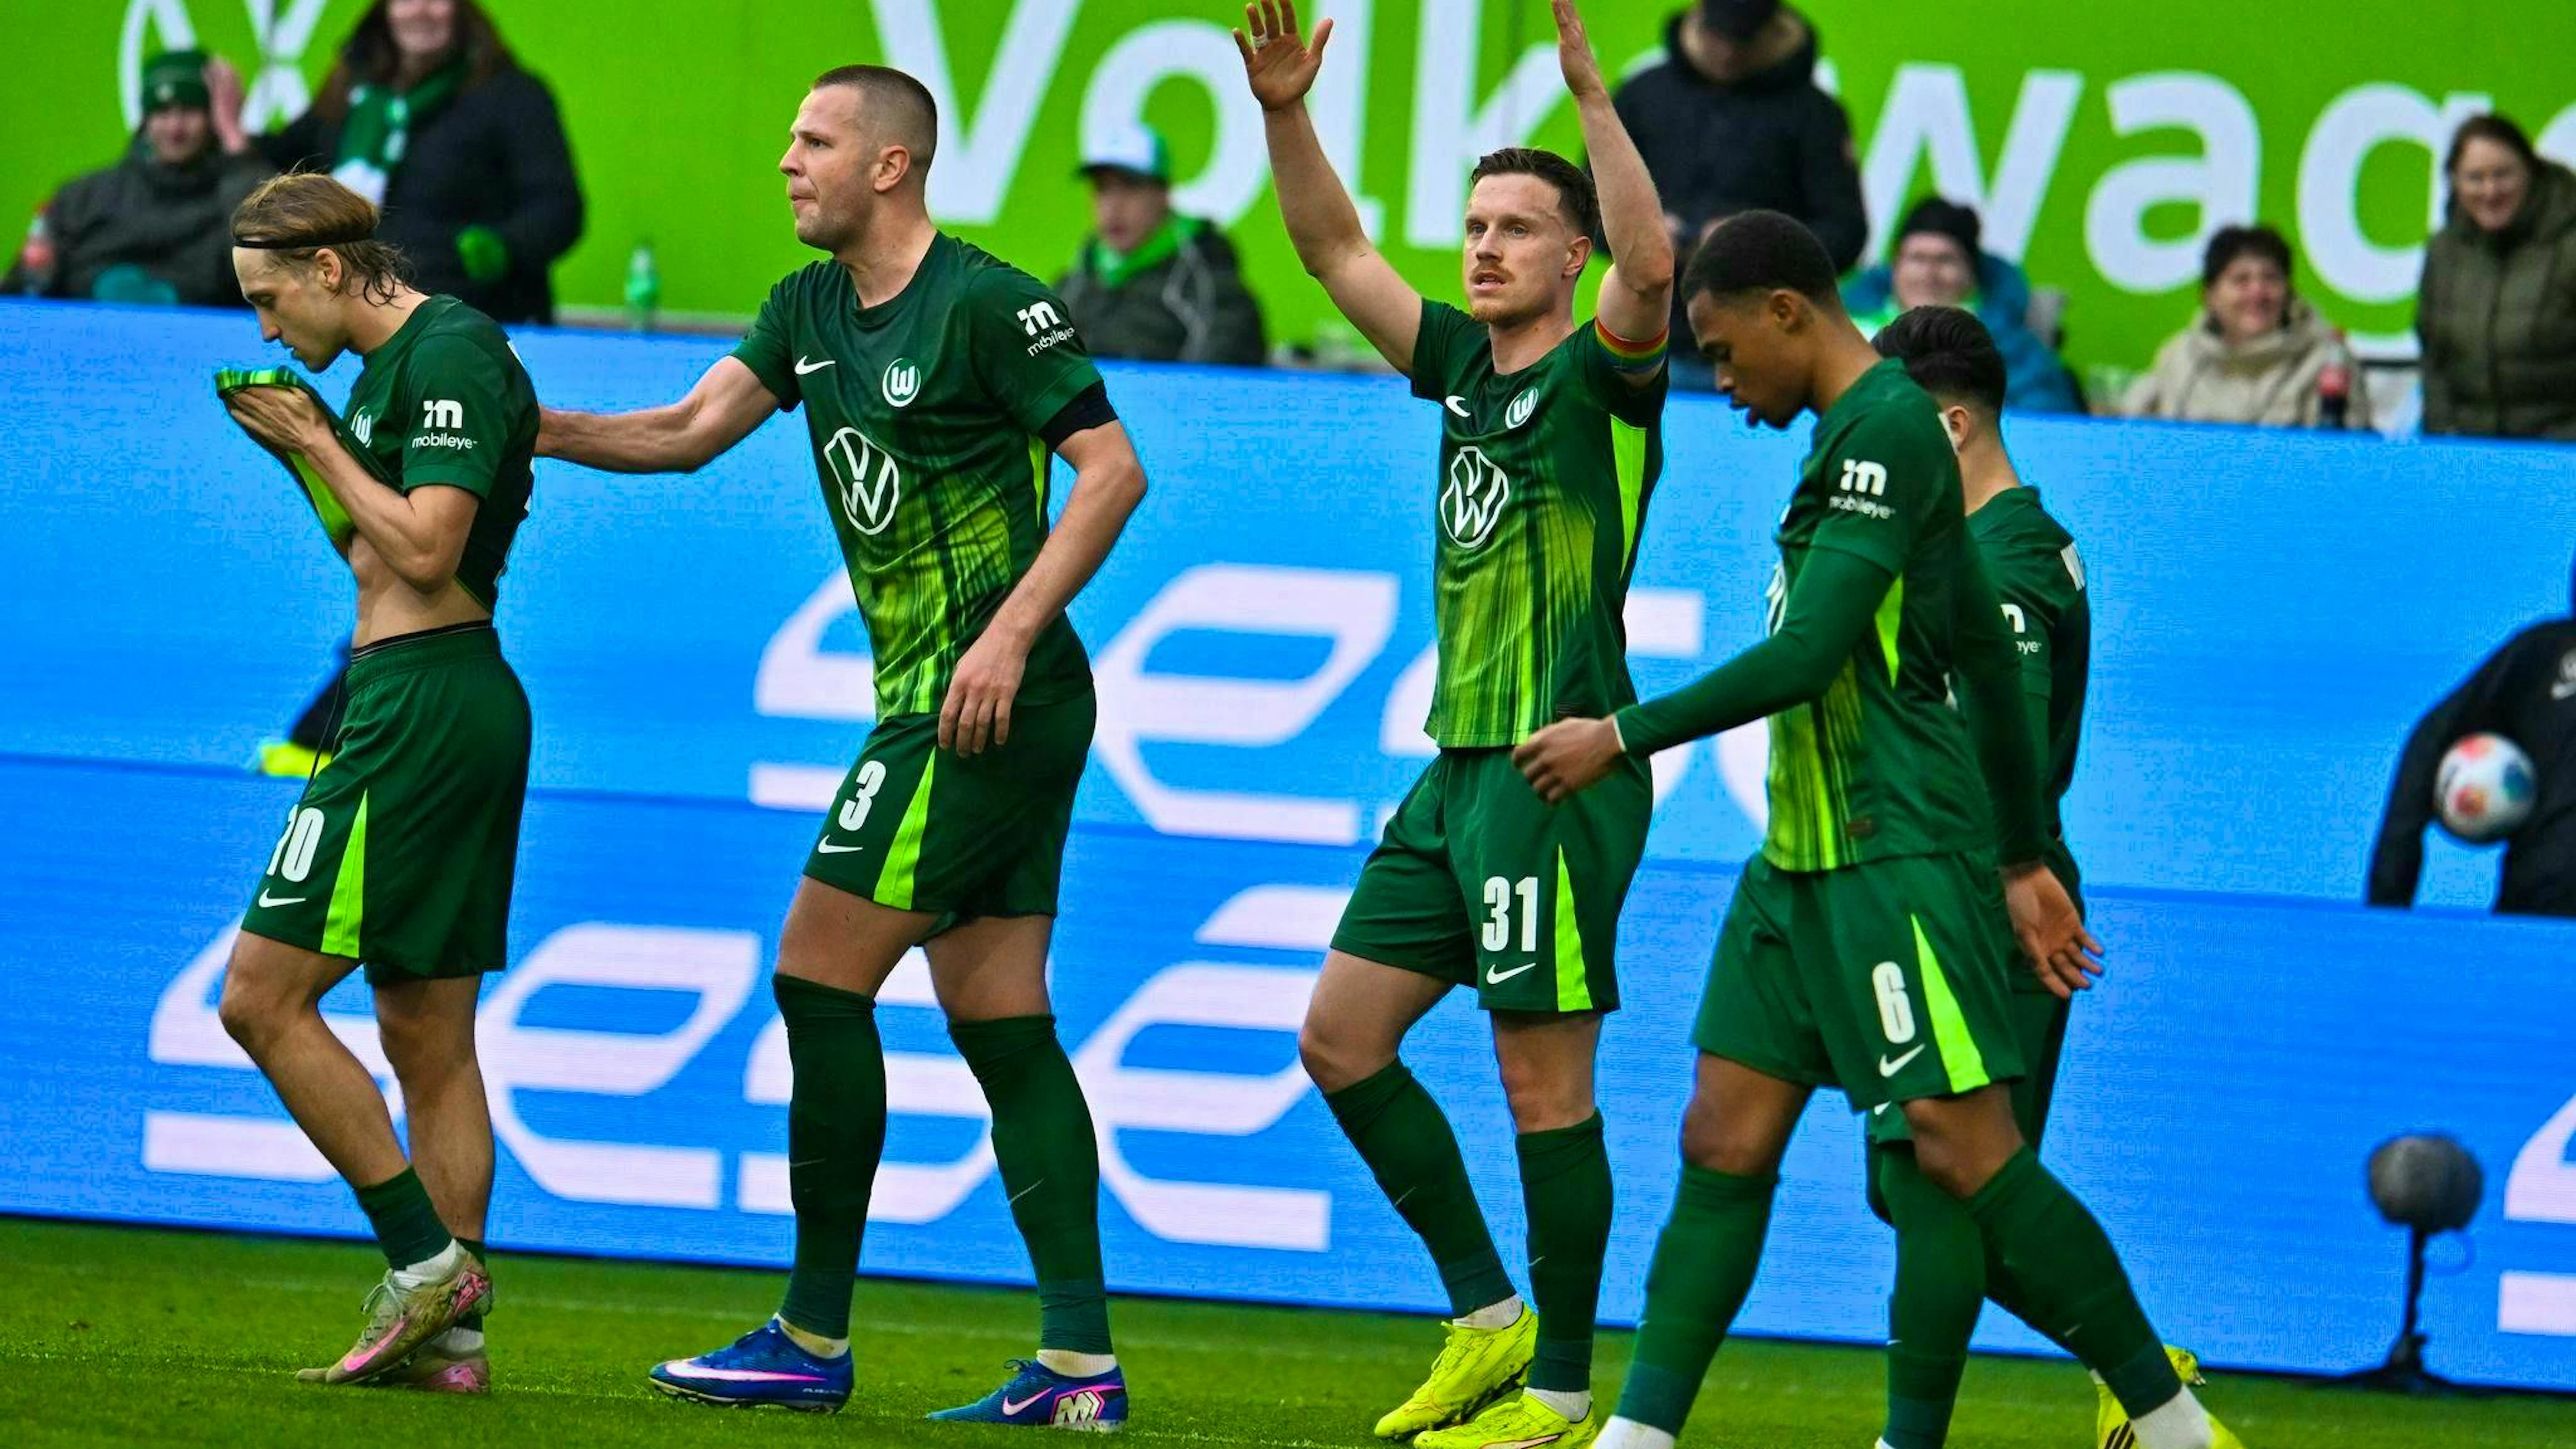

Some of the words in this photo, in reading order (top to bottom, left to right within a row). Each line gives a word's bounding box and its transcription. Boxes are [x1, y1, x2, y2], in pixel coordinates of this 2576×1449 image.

[873, 0, 2576, 361] Volkwag
[412, 432, 473, 450] mobileye
[839, 760, 886, 831] 3
[1482, 876, 1538, 952] 31
[1872, 961, 1915, 1044] 6
